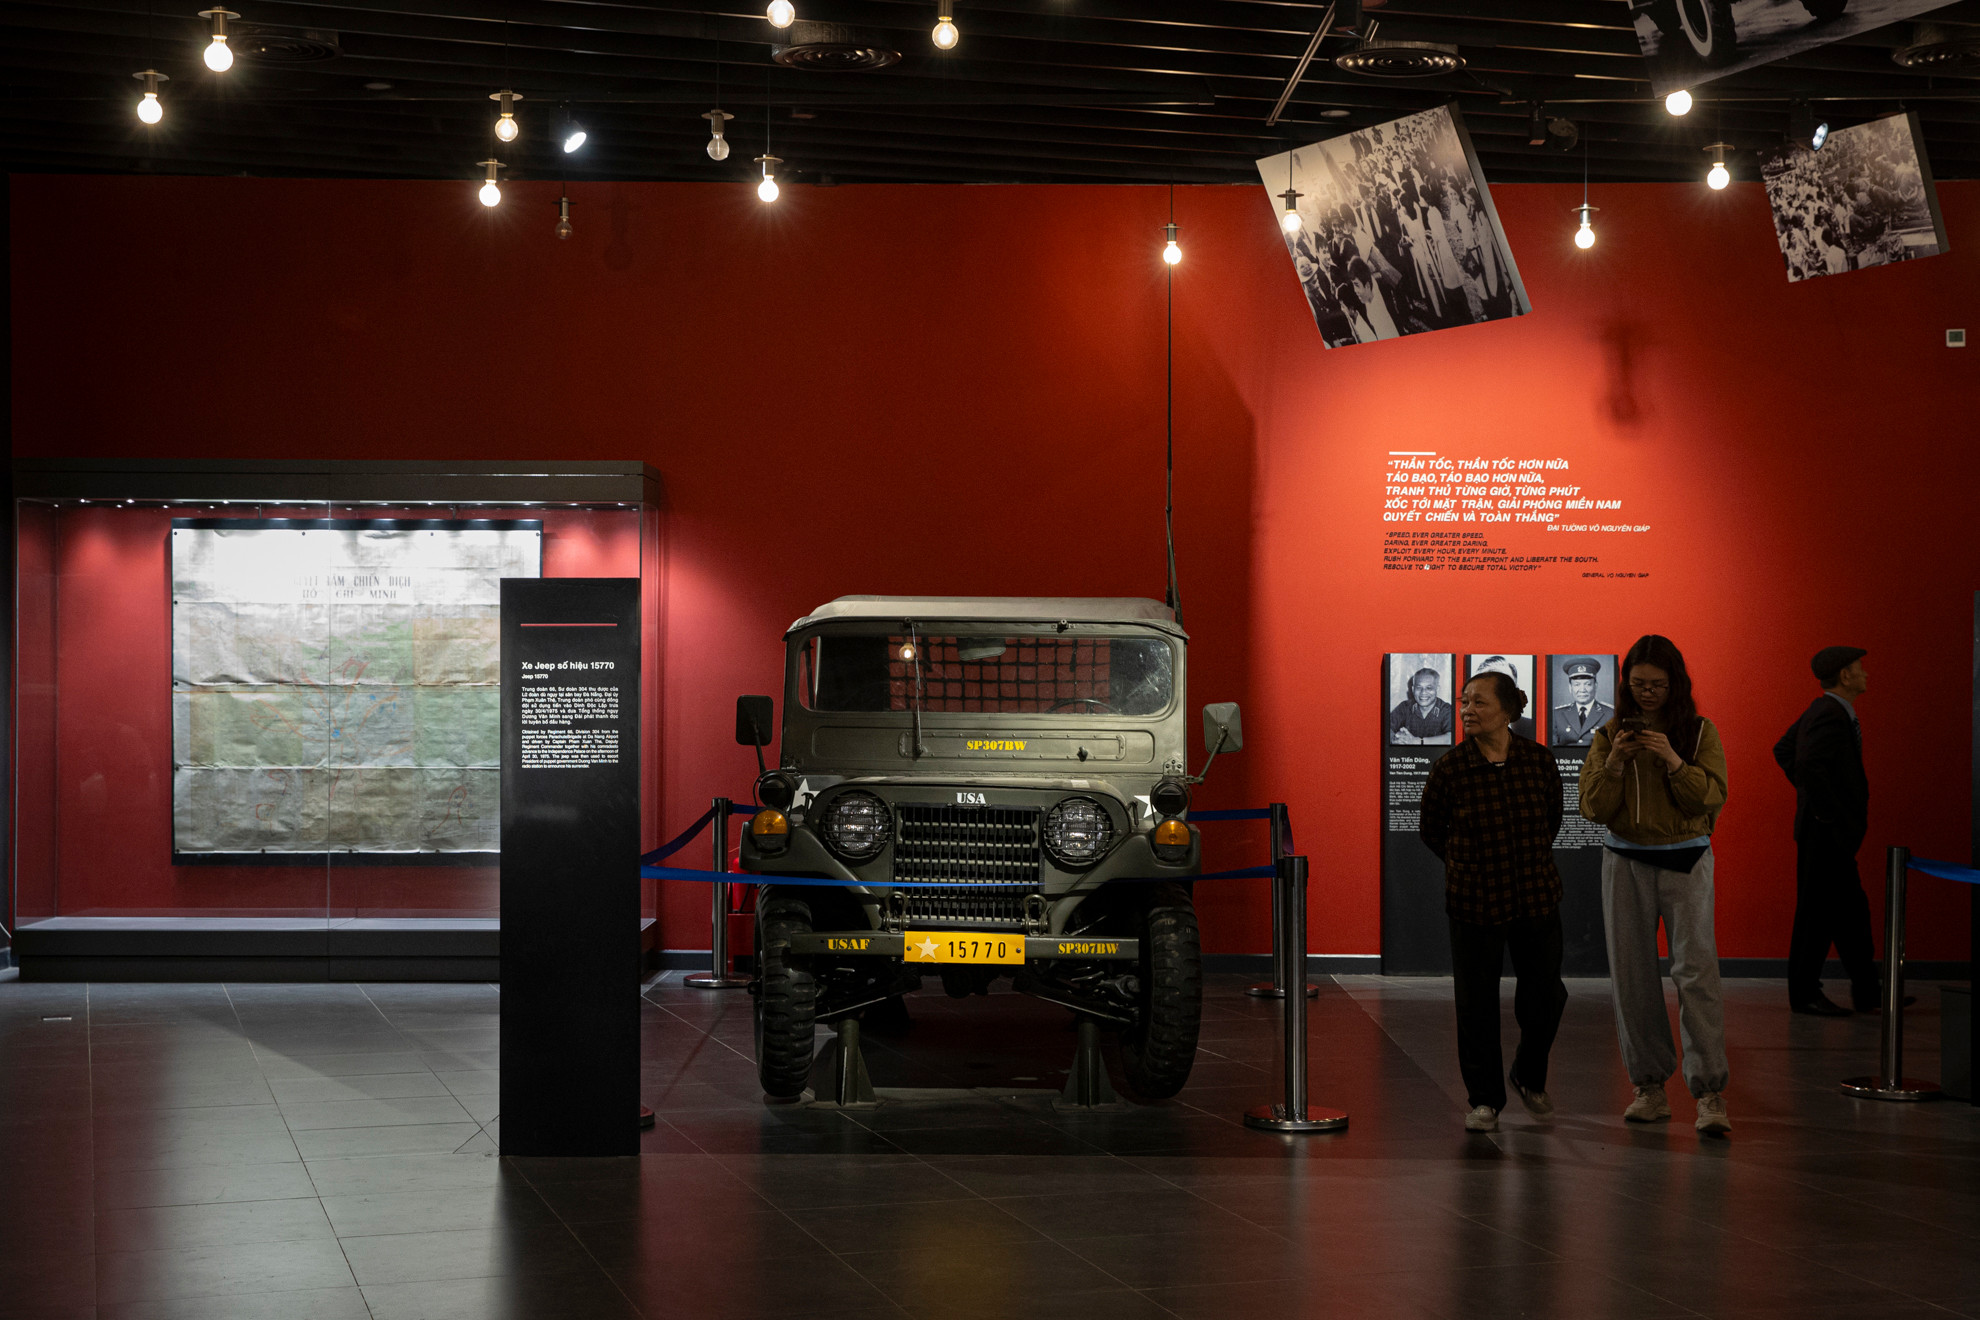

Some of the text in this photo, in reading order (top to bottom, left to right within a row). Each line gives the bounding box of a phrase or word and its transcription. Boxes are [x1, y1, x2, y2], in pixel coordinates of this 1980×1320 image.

[1388, 456, 1568, 470] “THẦN TỐC, THẦN TỐC HƠN NỮA
[1386, 471, 1544, 484] TÁO BẠO, TÁO BẠO HƠN NỮA,
[1386, 485, 1580, 497] TRANH THỦ TỪNG GIỜ, TỪNG PHÚT
[1385, 497, 1621, 510] XỐC TỚI MẶT TRẬN, GIẢI PHÓNG MIỀN NAM
[1383, 510, 1421, 522] QUYẾT
[1426, 511, 1459, 522] CHIẾN
[1463, 511, 1476, 522] VÀ
[1480, 512, 1510, 522] TOÀN
[535, 662, 555, 671] Jeep
[558, 661, 569, 669] số
[570, 662, 588, 670] hiệu
[966, 740, 1027, 751] SP307BW
[956, 792, 986, 804] USA
[827, 938, 870, 950] USAF
[948, 941, 1006, 958] 15770
[1058, 943, 1119, 954] SP307BW
